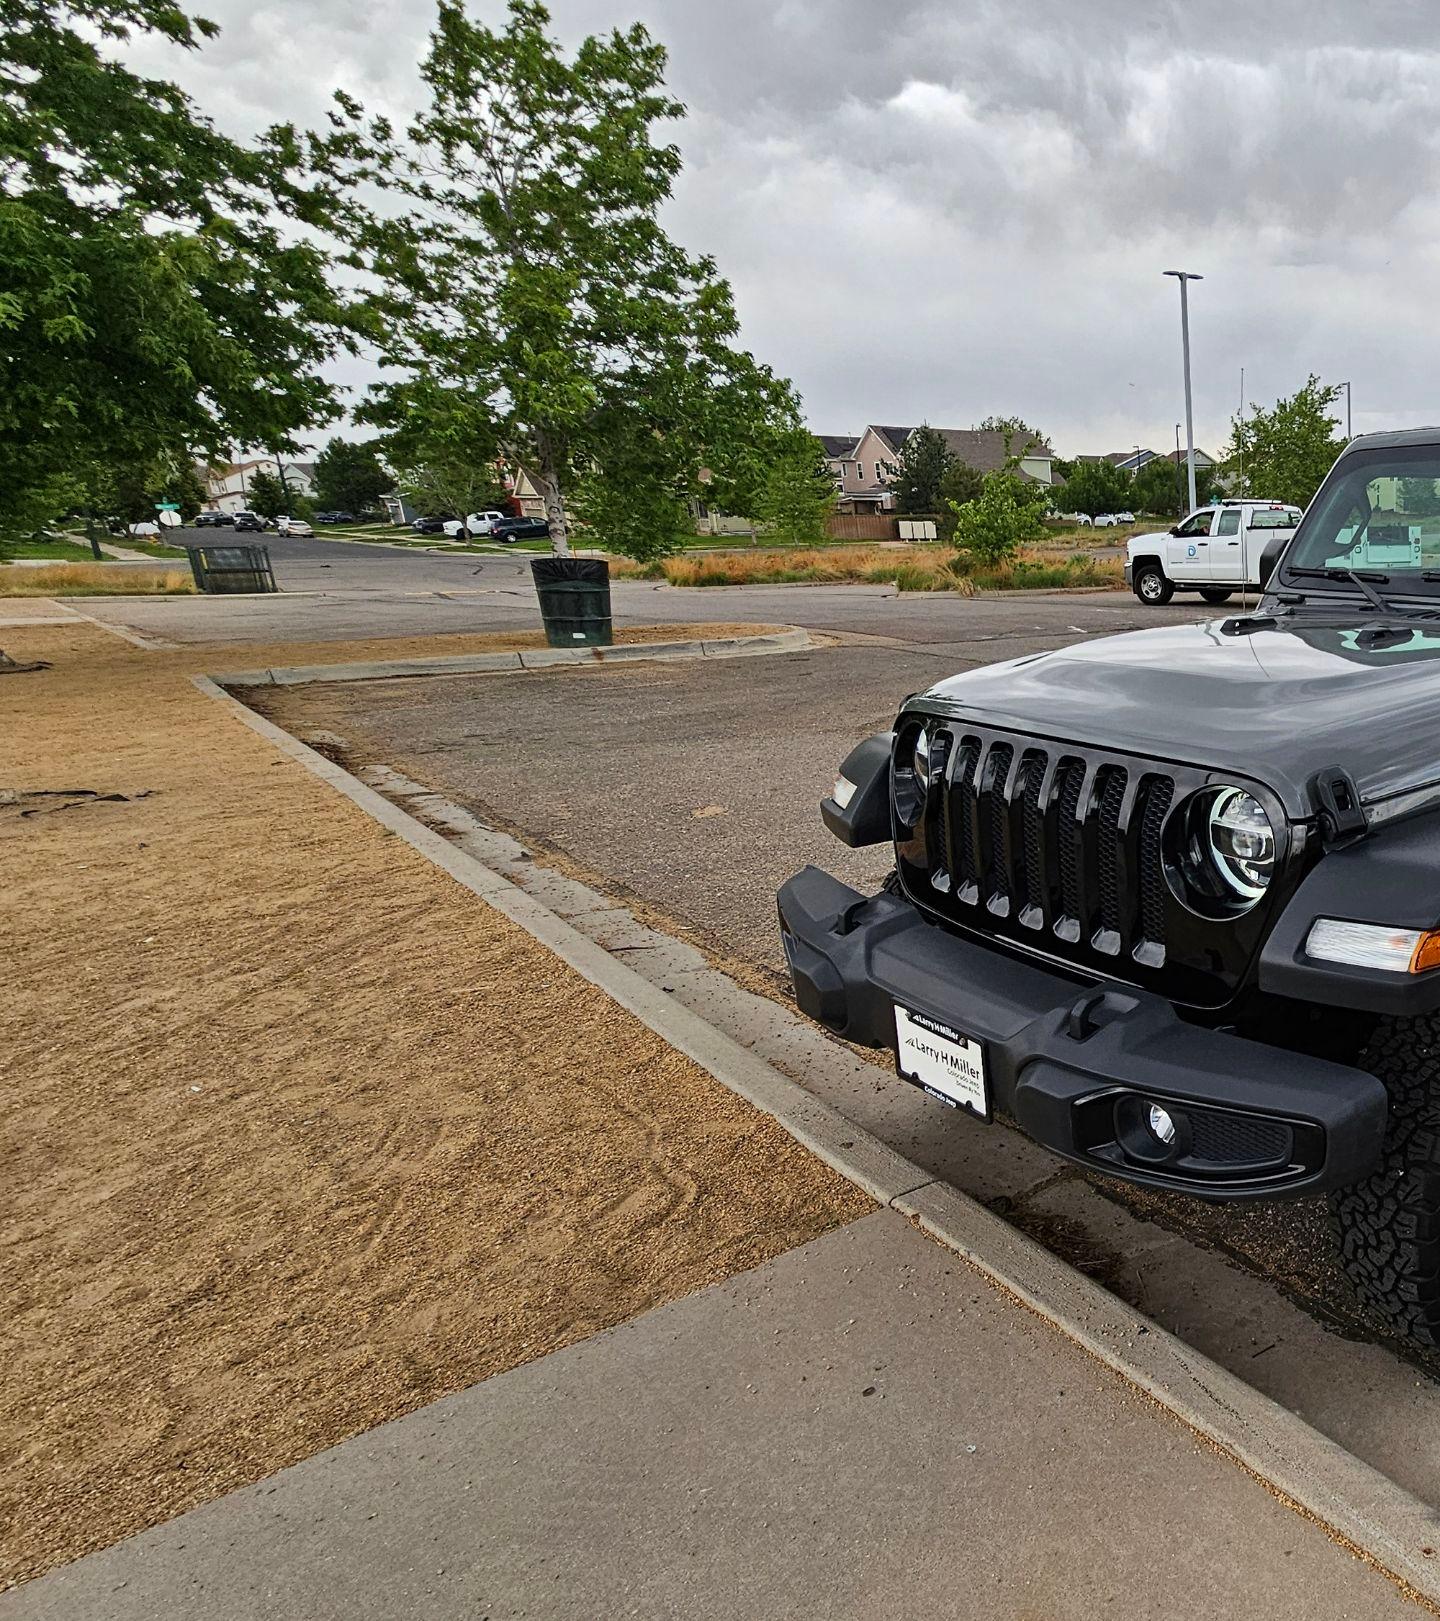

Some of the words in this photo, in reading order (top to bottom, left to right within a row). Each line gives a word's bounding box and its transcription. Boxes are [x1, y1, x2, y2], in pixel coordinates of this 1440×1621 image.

[919, 1014, 935, 1030] Larry
[940, 1025, 959, 1040] Miller
[915, 1037, 940, 1063] Larry
[941, 1050, 948, 1066] H
[950, 1055, 980, 1080] Miller
